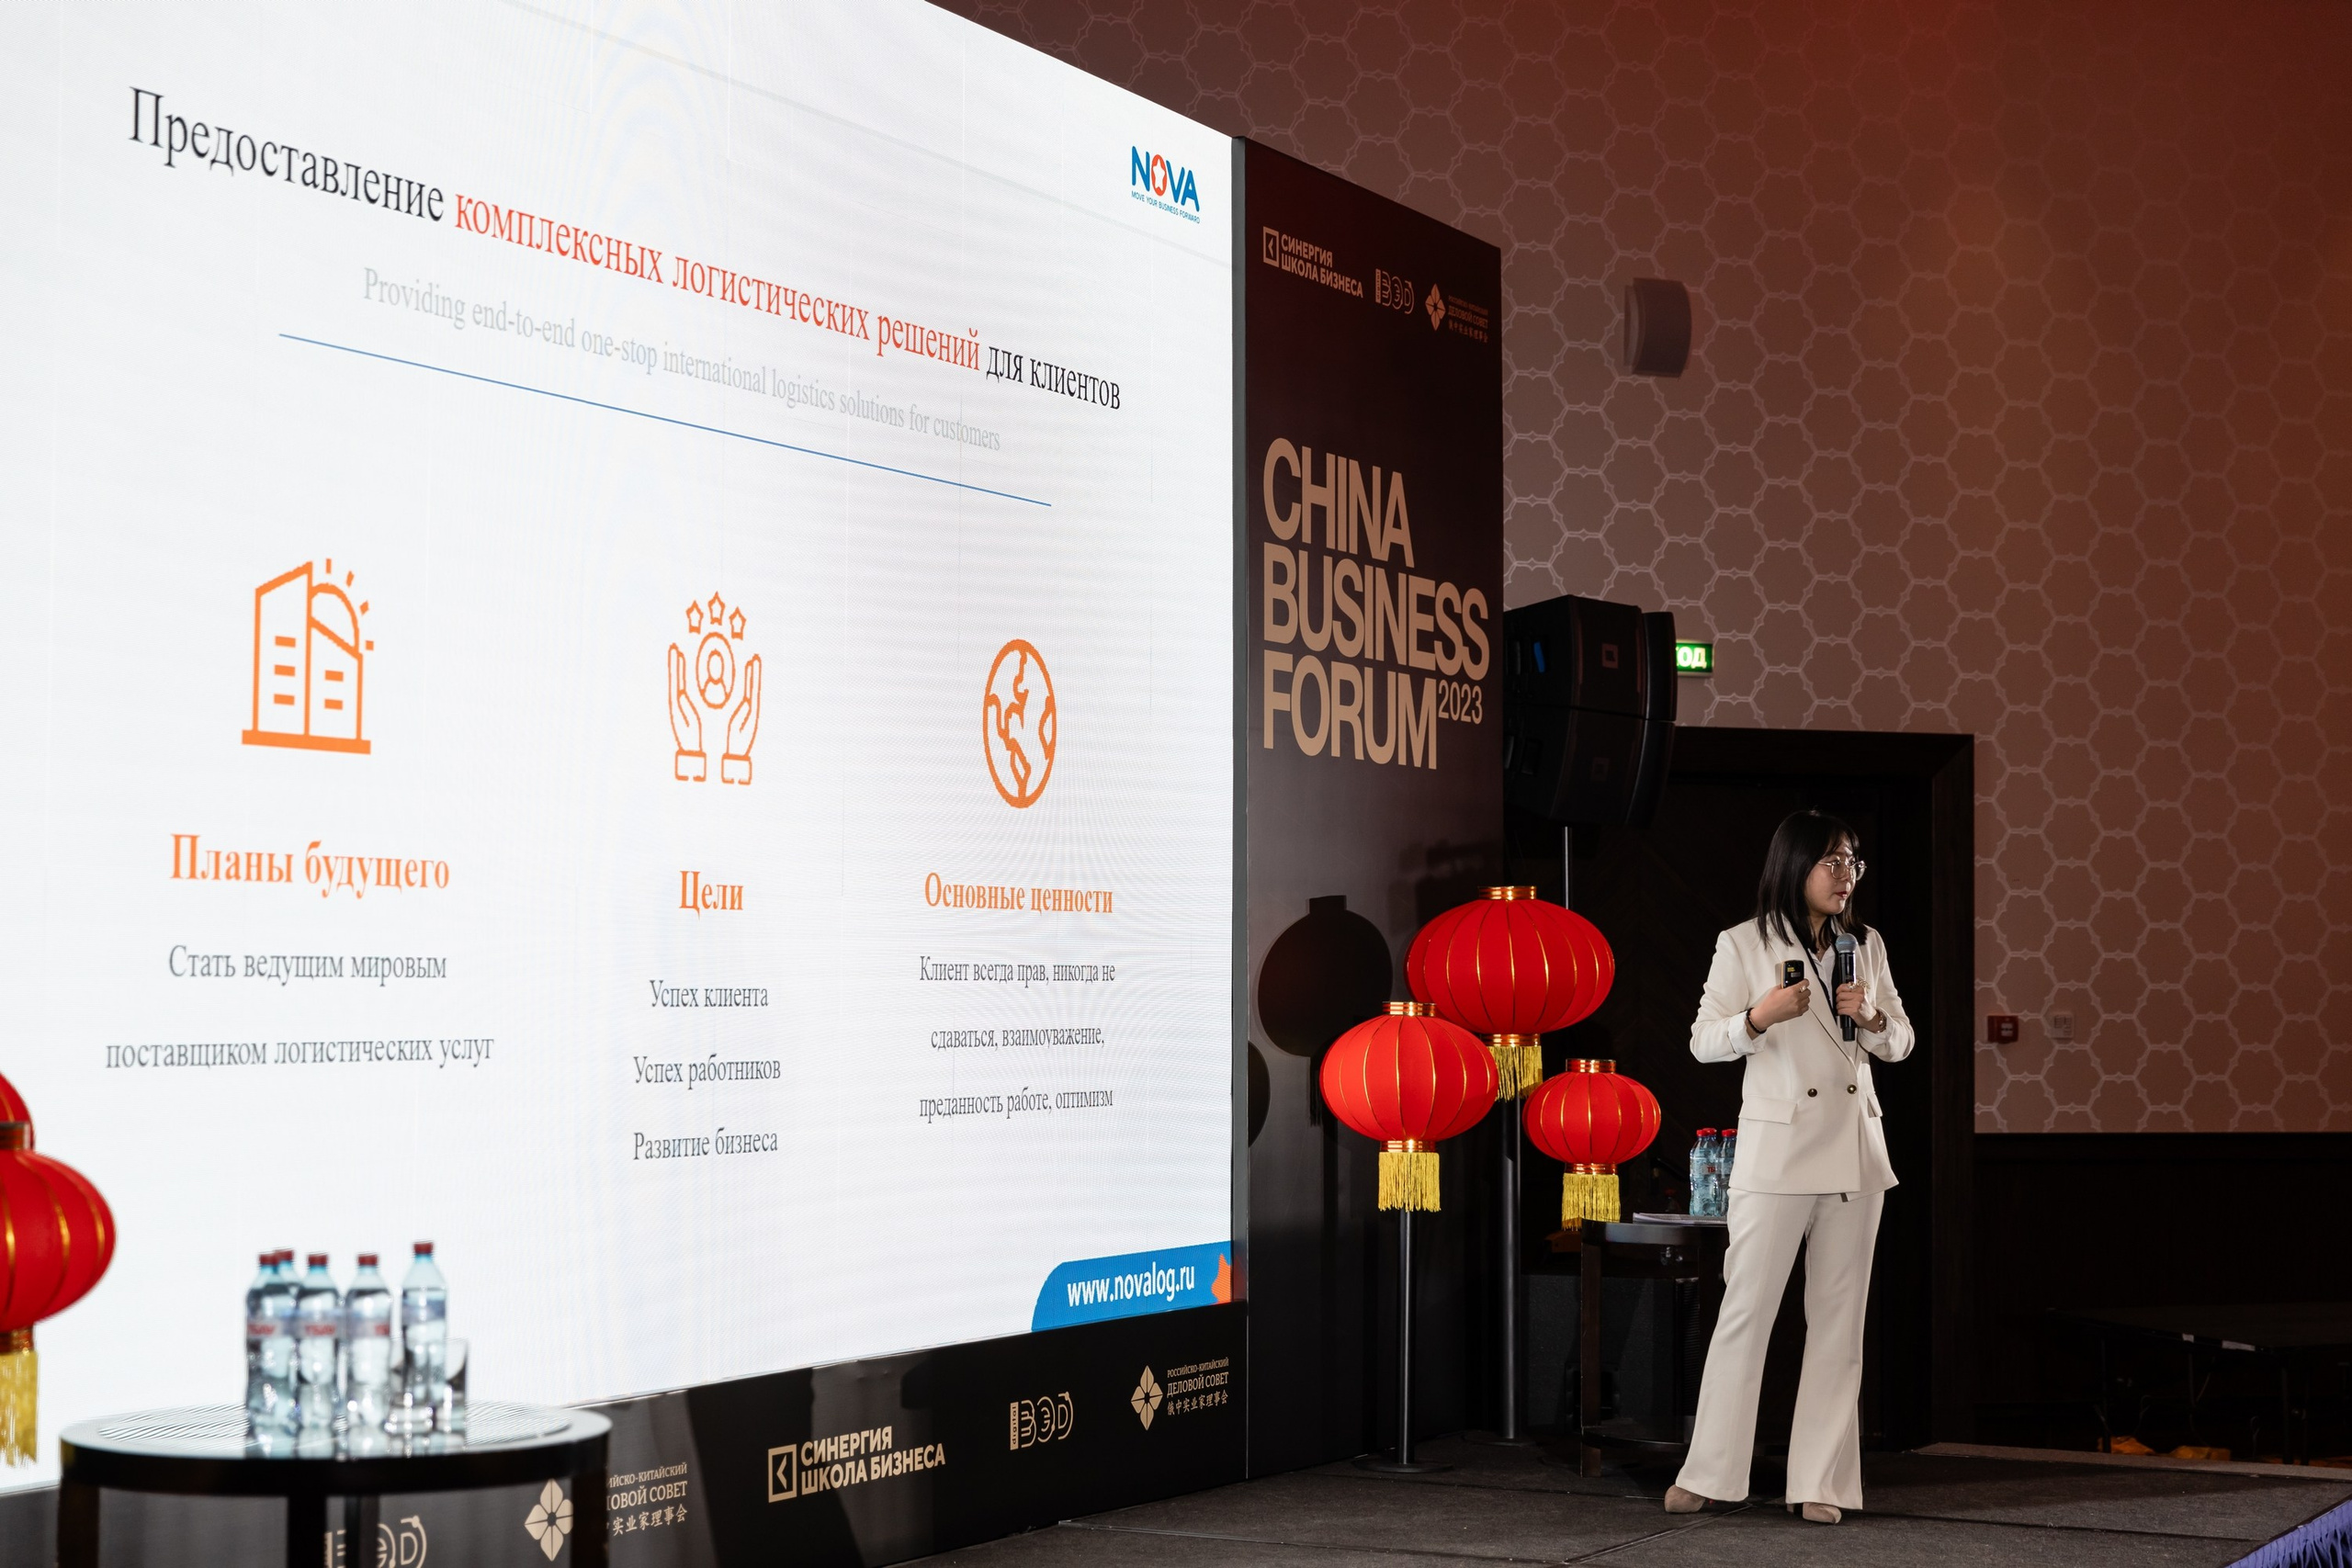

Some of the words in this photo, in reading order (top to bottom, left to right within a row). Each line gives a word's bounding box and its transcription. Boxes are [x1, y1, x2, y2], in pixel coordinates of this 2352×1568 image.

[1131, 145, 1200, 212] NOVA
[1131, 190, 1145, 202] MOVE
[1146, 196, 1158, 207] YOUR
[1159, 201, 1179, 216] BUSINESS
[1179, 209, 1201, 224] FORWARD
[129, 86, 445, 221] Предоставление
[455, 194, 664, 284] комплексных
[673, 256, 870, 341] логистических
[876, 314, 980, 371] решений
[986, 345, 1023, 383] для
[1030, 358, 1120, 410] клиентов
[1281, 233, 1333, 268] СИНЕРГИЯ
[1281, 253, 1319, 283] ШКОЛА
[1319, 265, 1363, 299] БИЗНЕСА
[363, 267, 466, 330] Providing
[471, 299, 576, 348] end-to-end
[581, 334, 658, 375] one-stop
[662, 340, 767, 395] international
[772, 368, 836, 411] logistics
[840, 389, 905, 428] solutions
[909, 403, 931, 435] for
[933, 415, 1001, 451] customers
[1263, 437, 1415, 569] CHINA
[1263, 542, 1490, 682] BUSINESS
[1263, 649, 1437, 770] FORUM
[1438, 680, 1483, 724] 2023
[170, 833, 294, 884] Планы
[304, 840, 450, 899] будущего
[678, 870, 744, 919] Цели
[924, 872, 1025, 910] Основные
[1030, 887, 1114, 915] ценности
[169, 944, 236, 977] Стать
[243, 953, 344, 986] ведущим
[351, 956, 447, 987] мировым
[920, 955, 969, 981] Клиент
[973, 964, 1013, 984] всегда
[1016, 964, 1049, 988] прав,
[1052, 964, 1099, 983] никогда
[1102, 964, 1115, 982] не
[649, 979, 699, 1008] Успех
[704, 987, 769, 1008] клиента
[106, 1042, 267, 1069] поставщиком
[275, 1039, 433, 1066] логистических
[439, 1037, 494, 1068] услуг
[931, 1028, 999, 1051] сдаваться,
[1001, 1027, 1105, 1049] взаимоуважение,
[633, 1056, 684, 1084] Успех
[687, 1054, 781, 1090] работников
[919, 1094, 1003, 1124] преданность
[1007, 1086, 1052, 1120] работе,
[1056, 1089, 1114, 1110] оптимизм
[633, 1133, 710, 1160] Развитие
[715, 1127, 779, 1156] бизнеса
[1067, 1262, 1195, 1307] www.novalog.ru
[1166, 1356, 1229, 1378] РОССИЙСКО-КИТАЙСКИЙ
[1166, 1373, 1204, 1399] ДЕЛОВОЙ
[1204, 1371, 1229, 1388] СОВЕТ
[800, 1425, 892, 1467] СИНЕРГИЯ
[607, 1461, 688, 1488] ИЙСКО-КИТАЙСКИЙ
[800, 1459, 868, 1495] ШКОЛА
[870, 1442, 946, 1481] БИЗНЕСА
[606, 1485, 648, 1511] ОВОЙ
[649, 1480, 689, 1503] СОВЕТ
[606, 1503, 688, 1537] 实业家理事会
